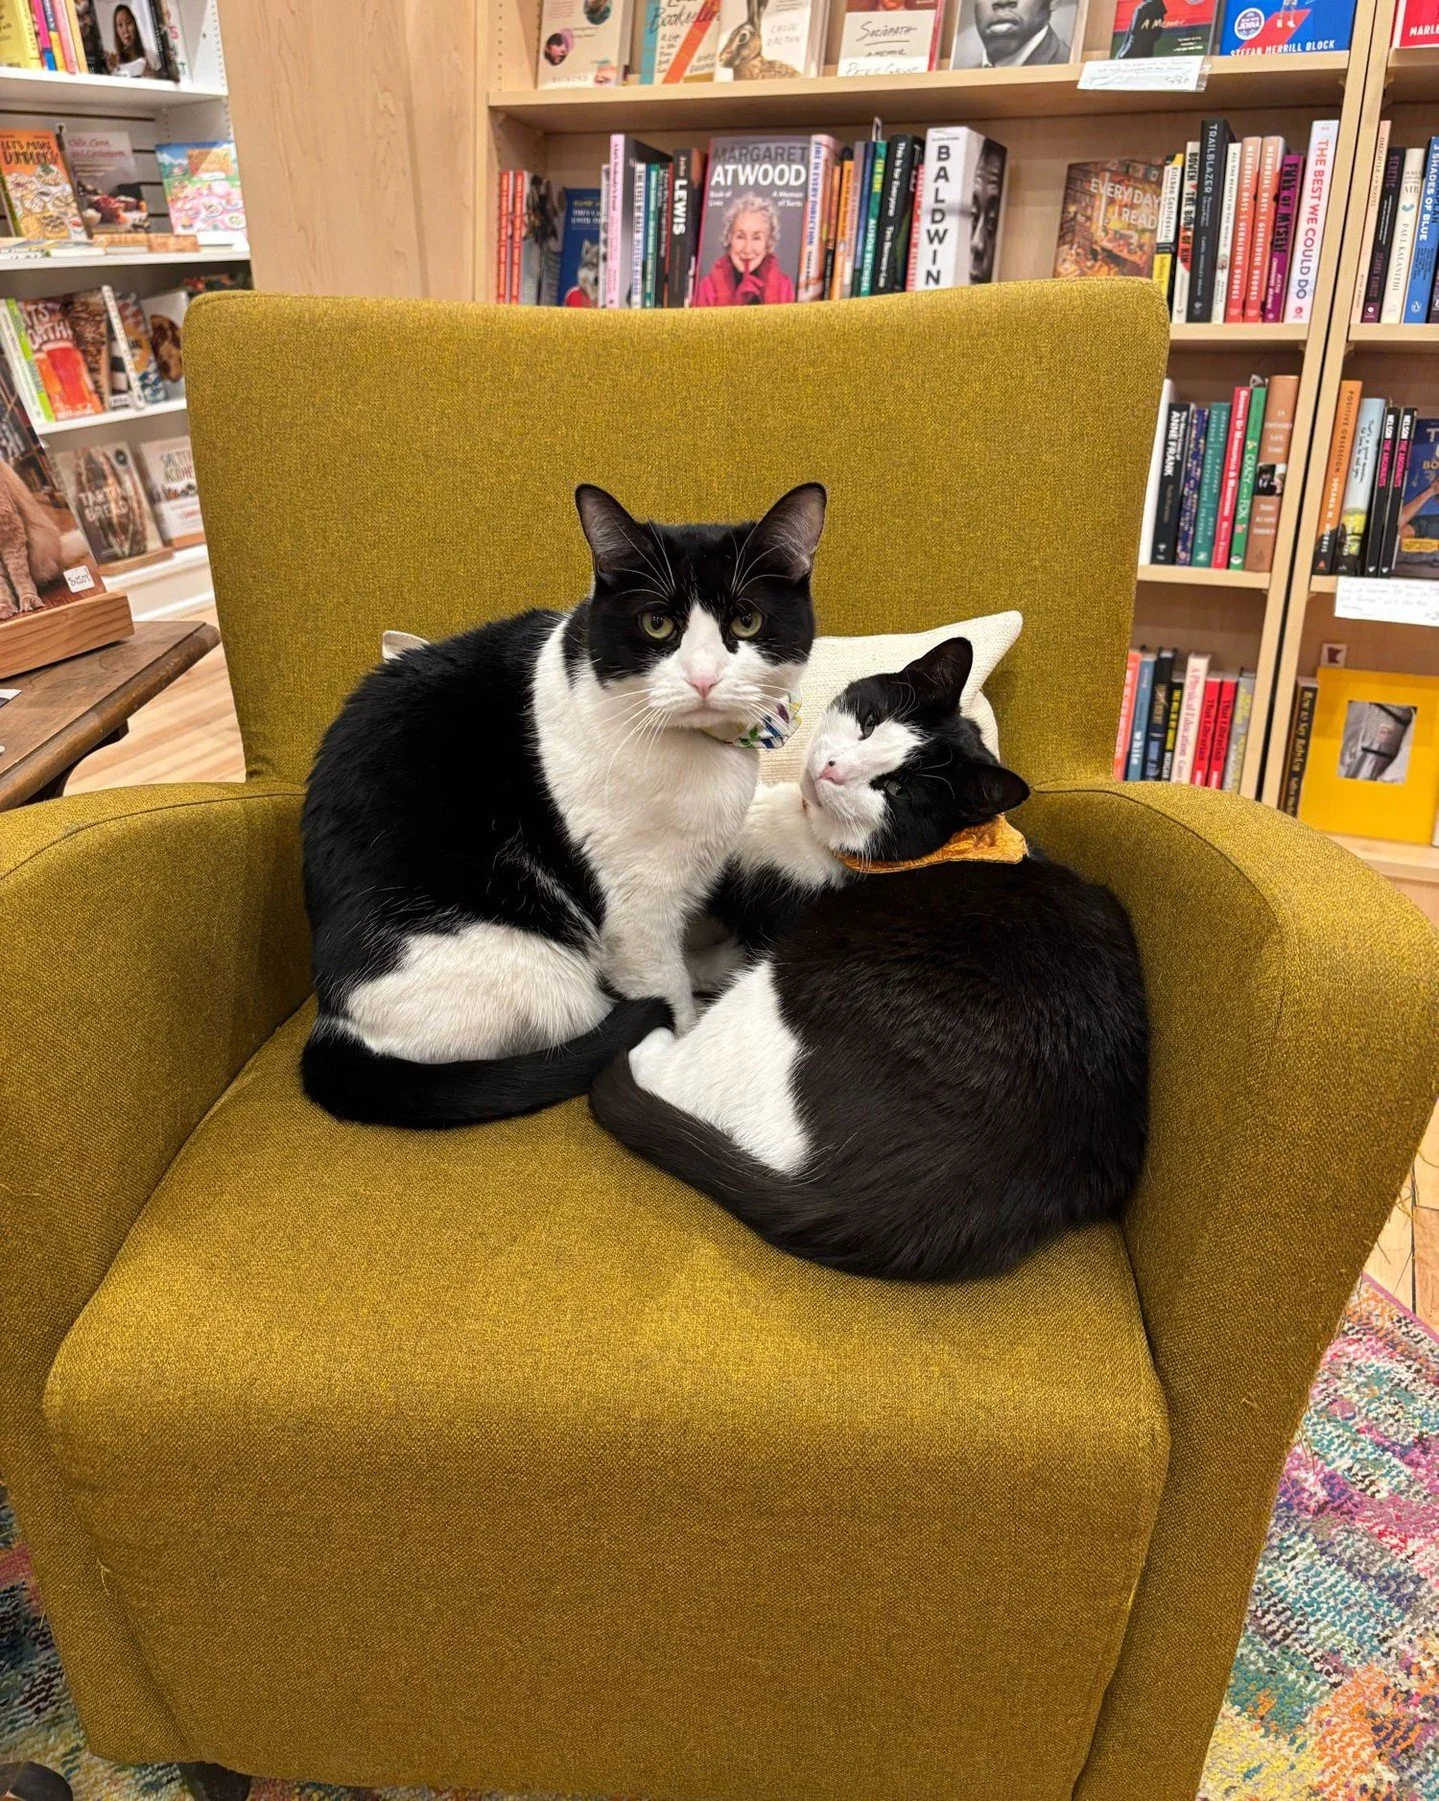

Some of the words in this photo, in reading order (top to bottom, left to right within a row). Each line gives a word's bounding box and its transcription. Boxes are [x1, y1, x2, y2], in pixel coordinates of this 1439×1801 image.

[1141, 19, 1150, 29] A
[1152, 17, 1187, 30] Memoir
[1238, 21, 1260, 31] JENNA
[1305, 40, 1335, 51] BLOCK
[679, 156, 688, 176] John
[715, 145, 809, 163] MARGARET
[1188, 152, 1198, 181] BOWEN
[1204, 124, 1218, 194] TRAILBLAZER
[1243, 145, 1254, 188] MEMORIAL
[1262, 145, 1274, 189] MEMORIAL
[1315, 140, 1329, 166] THE
[711, 164, 808, 187] ATWOOD
[811, 173, 820, 199] EVERY
[1281, 163, 1298, 191] FULL
[1310, 170, 1325, 201] BEST
[1425, 151, 1439, 194] SHADES
[674, 178, 688, 235] LEWIS
[887, 181, 899, 217] Everyone
[1090, 178, 1131, 200] EVERY
[1133, 189, 1161, 208] DAY
[1185, 191, 1196, 207] THE
[1241, 192, 1250, 212] DAYS
[1260, 192, 1269, 212] DAYS
[1424, 197, 1434, 208] OF
[925, 145, 951, 286] BALDWIN
[1122, 208, 1158, 230] READ
[1183, 210, 1194, 232] BOOK
[1307, 204, 1320, 225] WE
[1419, 215, 1431, 241] BLUE
[864, 218, 878, 250] ALISON
[1235, 221, 1247, 265] GERALDINE
[1253, 221, 1266, 266] GERALDINE
[1272, 213, 1291, 253] MYSELF
[1300, 227, 1316, 275] COULD
[1231, 269, 1241, 300] BROOKS
[1250, 270, 1260, 301] BROOKS
[1296, 278, 1308, 300] DO
[1343, 390, 1354, 426] POSITIVE
[1168, 411, 1181, 439] ANNE
[1385, 414, 1395, 439] NELSON
[1401, 414, 1411, 439] NELSON
[1164, 441, 1177, 477] FRANK
[1335, 428, 1349, 473] OBSESSION
[1383, 440, 1392, 450] THE
[1399, 440, 1408, 450] THE
[1242, 455, 1255, 486] CRAZY
[1205, 699, 1215, 718] That
[1221, 700, 1231, 719] That
[1130, 731, 1142, 765] white
[1198, 720, 1212, 761] Librarian
[1214, 721, 1228, 762] Librarian
